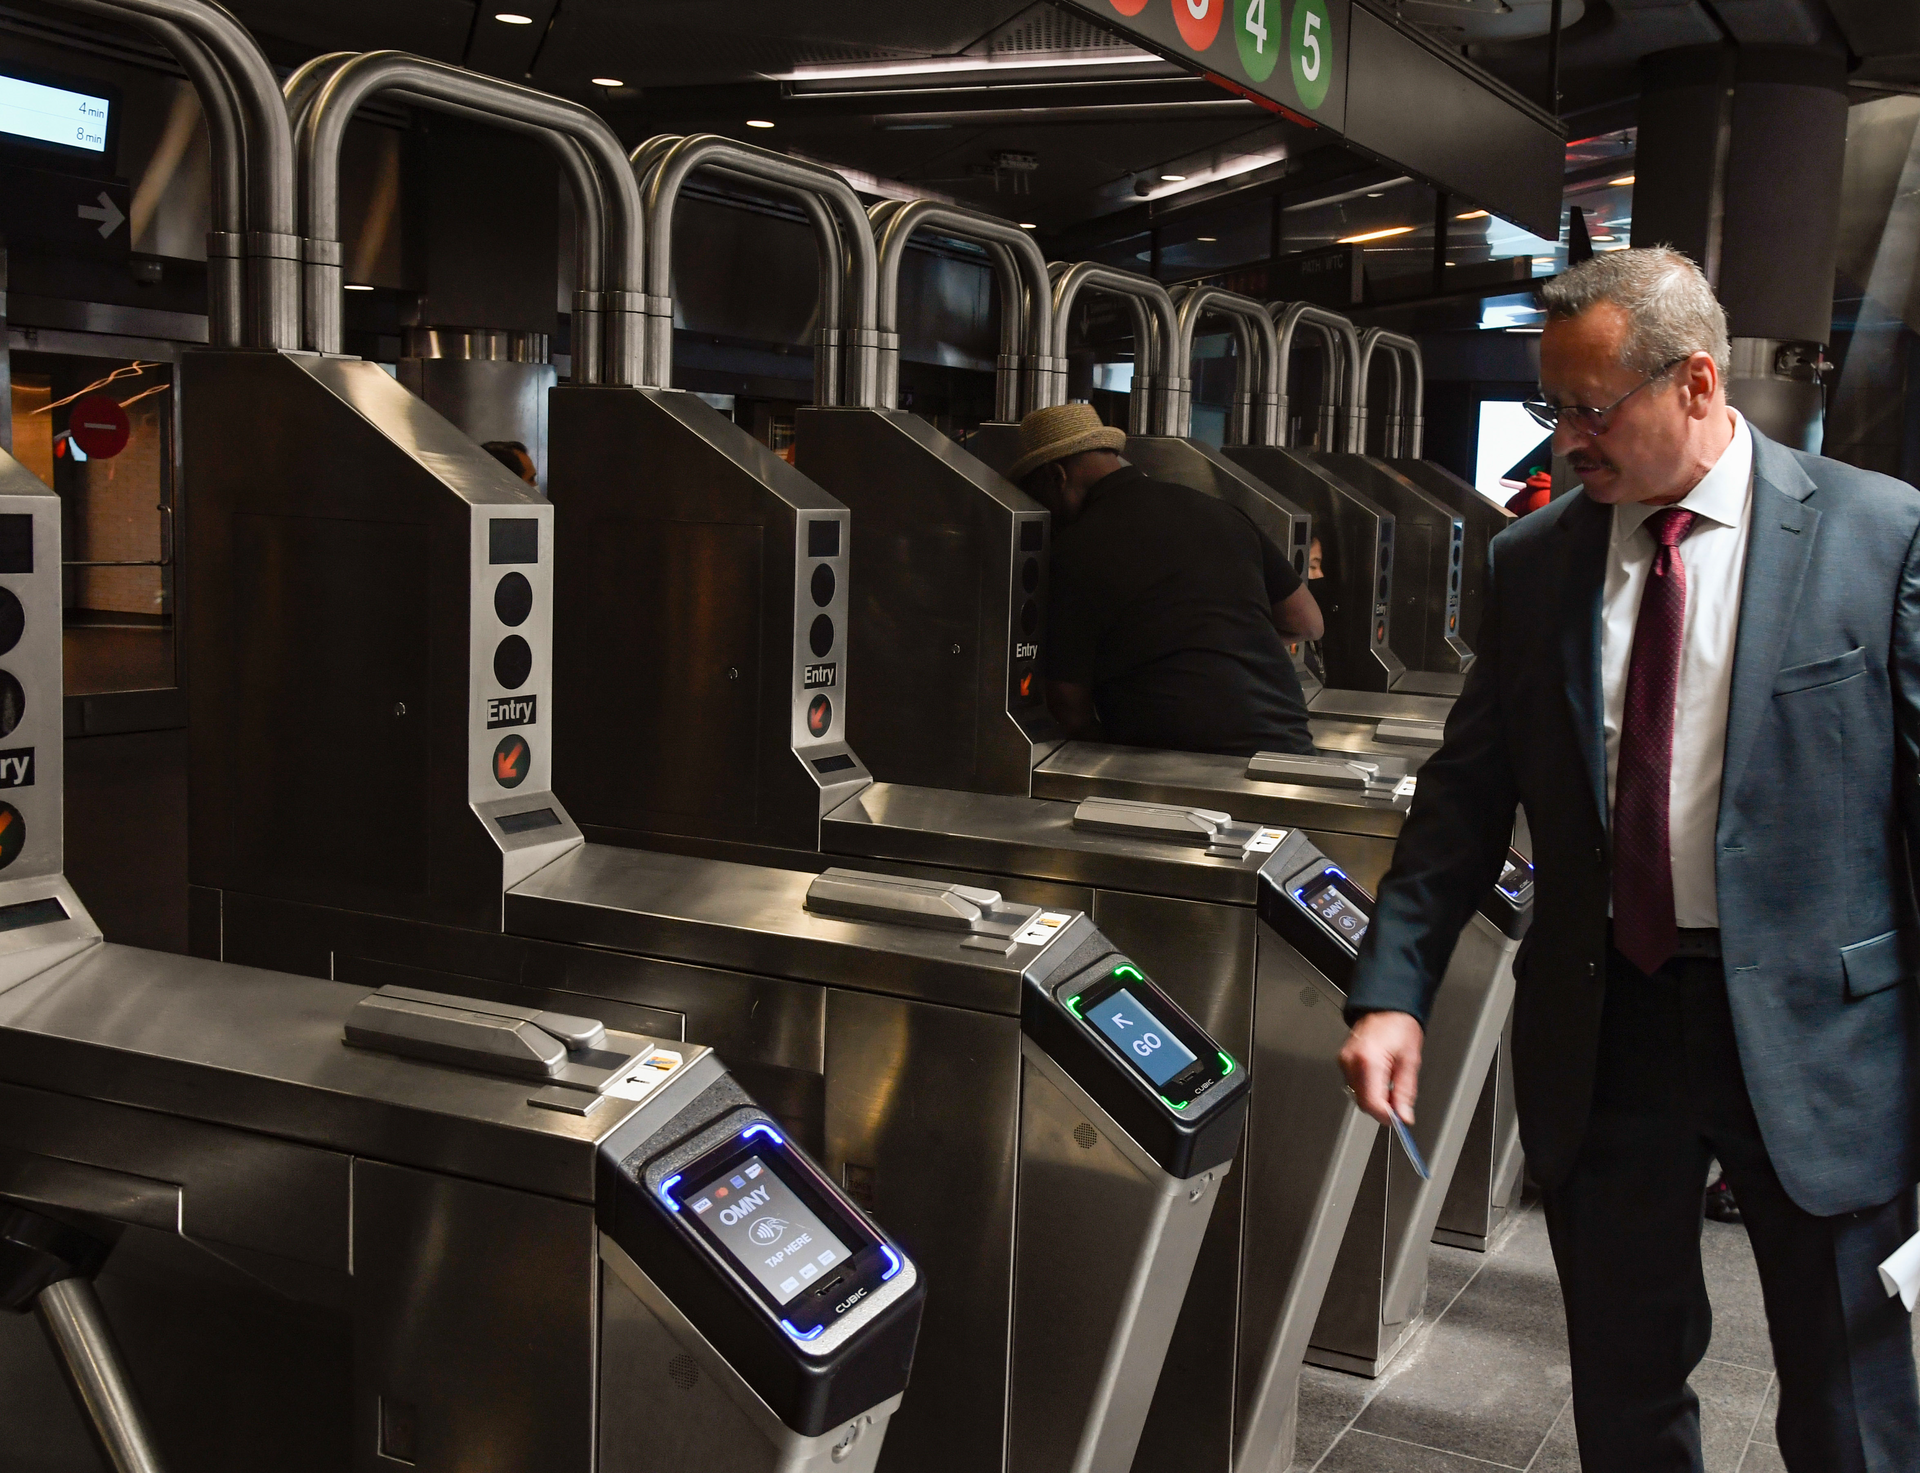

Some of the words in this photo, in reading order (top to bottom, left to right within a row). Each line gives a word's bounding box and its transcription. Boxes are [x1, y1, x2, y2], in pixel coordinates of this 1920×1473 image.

[1245, 0, 1268, 54] 4
[1301, 10, 1321, 82] 5
[78, 101, 87, 115] 4
[87, 107, 105, 119] min
[76, 127, 85, 141] 8
[85, 133, 102, 144] min
[1016, 642, 1038, 660] Entry
[804, 666, 834, 686] Entry
[487, 699, 533, 724] Entry
[0, 756, 30, 785] ry
[1322, 900, 1345, 919] OMNY
[1132, 1032, 1162, 1057] GO
[1194, 1078, 1215, 1095] CUBIC
[719, 1184, 771, 1226] OMNY
[765, 1250, 785, 1268] TAP
[787, 1232, 813, 1256] HERE
[835, 1287, 868, 1314] CUBIC
